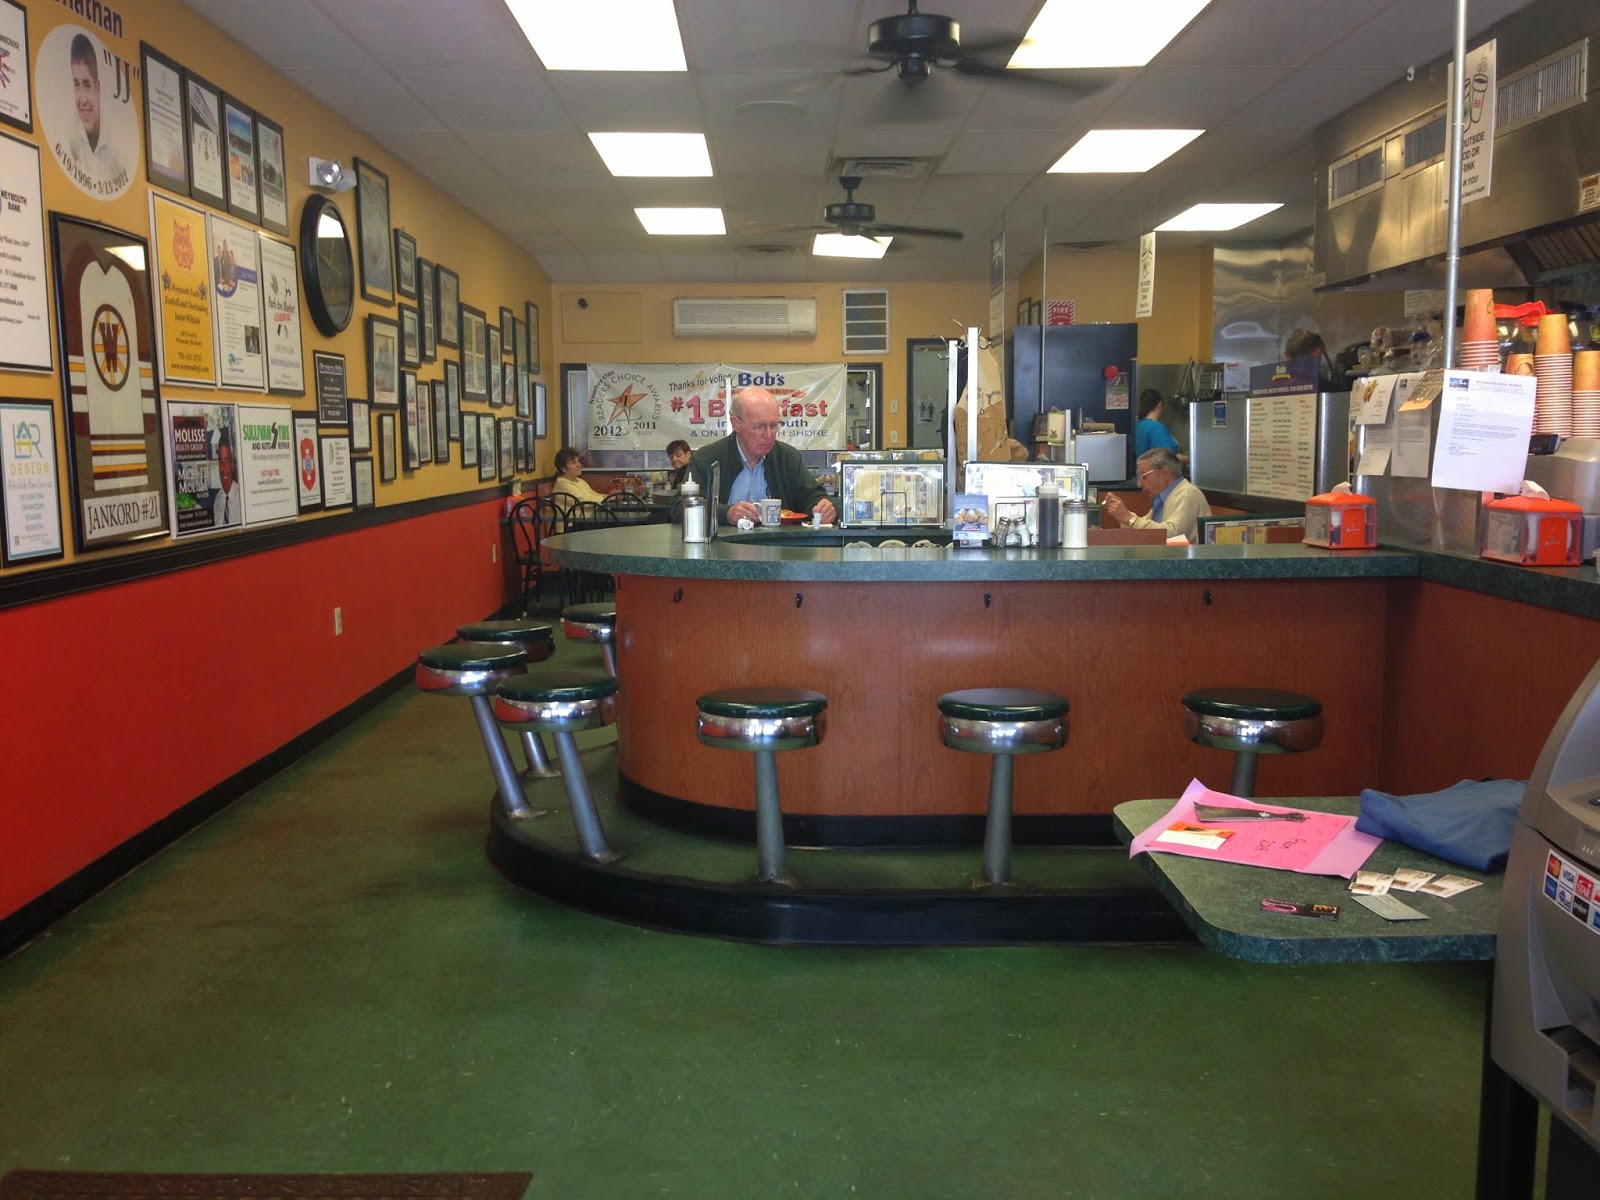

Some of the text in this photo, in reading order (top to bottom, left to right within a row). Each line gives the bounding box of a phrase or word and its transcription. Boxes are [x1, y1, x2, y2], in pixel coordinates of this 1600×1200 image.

[53, 0, 122, 39] athan
[1463, 160, 1475, 172] RINK
[1, 190, 27, 205] WEYMOUTH
[8, 202, 21, 213] BANK
[669, 380, 695, 392] Thanks
[697, 377, 707, 385] for
[738, 372, 785, 387] Bob's
[589, 371, 615, 404] Number One
[596, 373, 661, 421] READERS CHOICE AWARDS
[671, 395, 705, 424] #1
[174, 428, 206, 442] MOLISSE
[243, 424, 290, 441] SULLIVAN TIRE
[594, 421, 656, 437] 2012 2011
[190, 442, 204, 451] GROUP
[10, 463, 49, 475] DESIGN
[88, 501, 140, 535] JANKORD
[141, 496, 159, 520] #21
[1562, 869, 1575, 883] VISA
